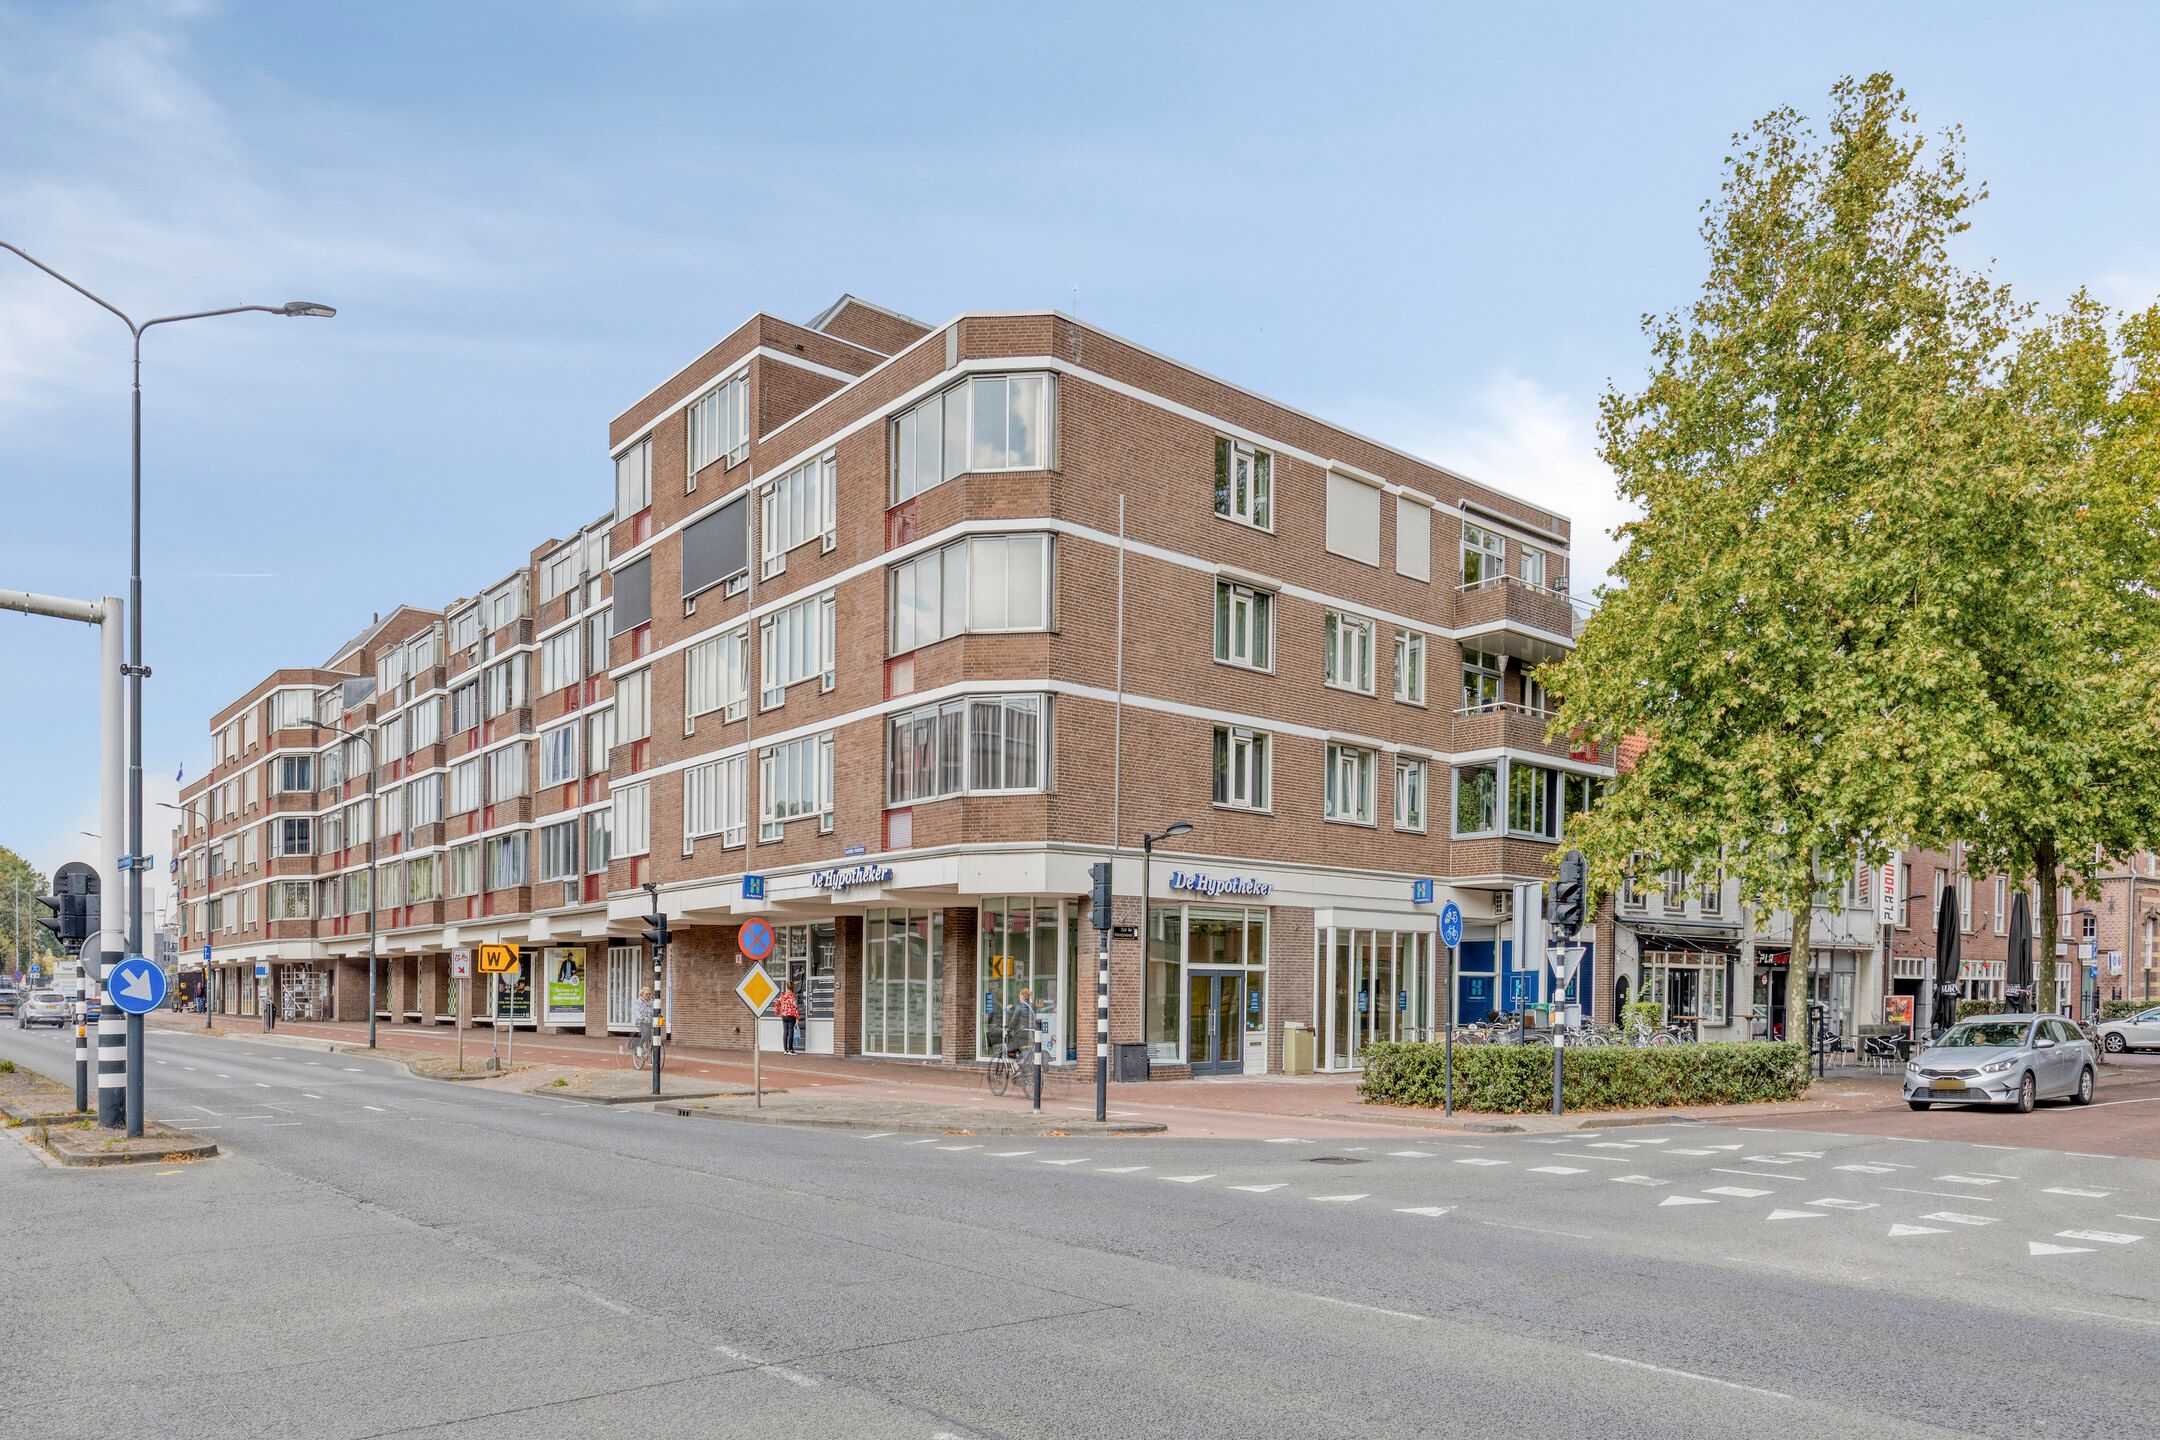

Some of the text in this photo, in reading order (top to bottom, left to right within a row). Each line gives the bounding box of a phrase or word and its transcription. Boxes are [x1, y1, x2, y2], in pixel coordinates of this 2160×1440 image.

[811, 865, 890, 890] De Hypotheker
[1172, 871, 1274, 896] De Hypotheker
[487, 952, 501, 966] W
